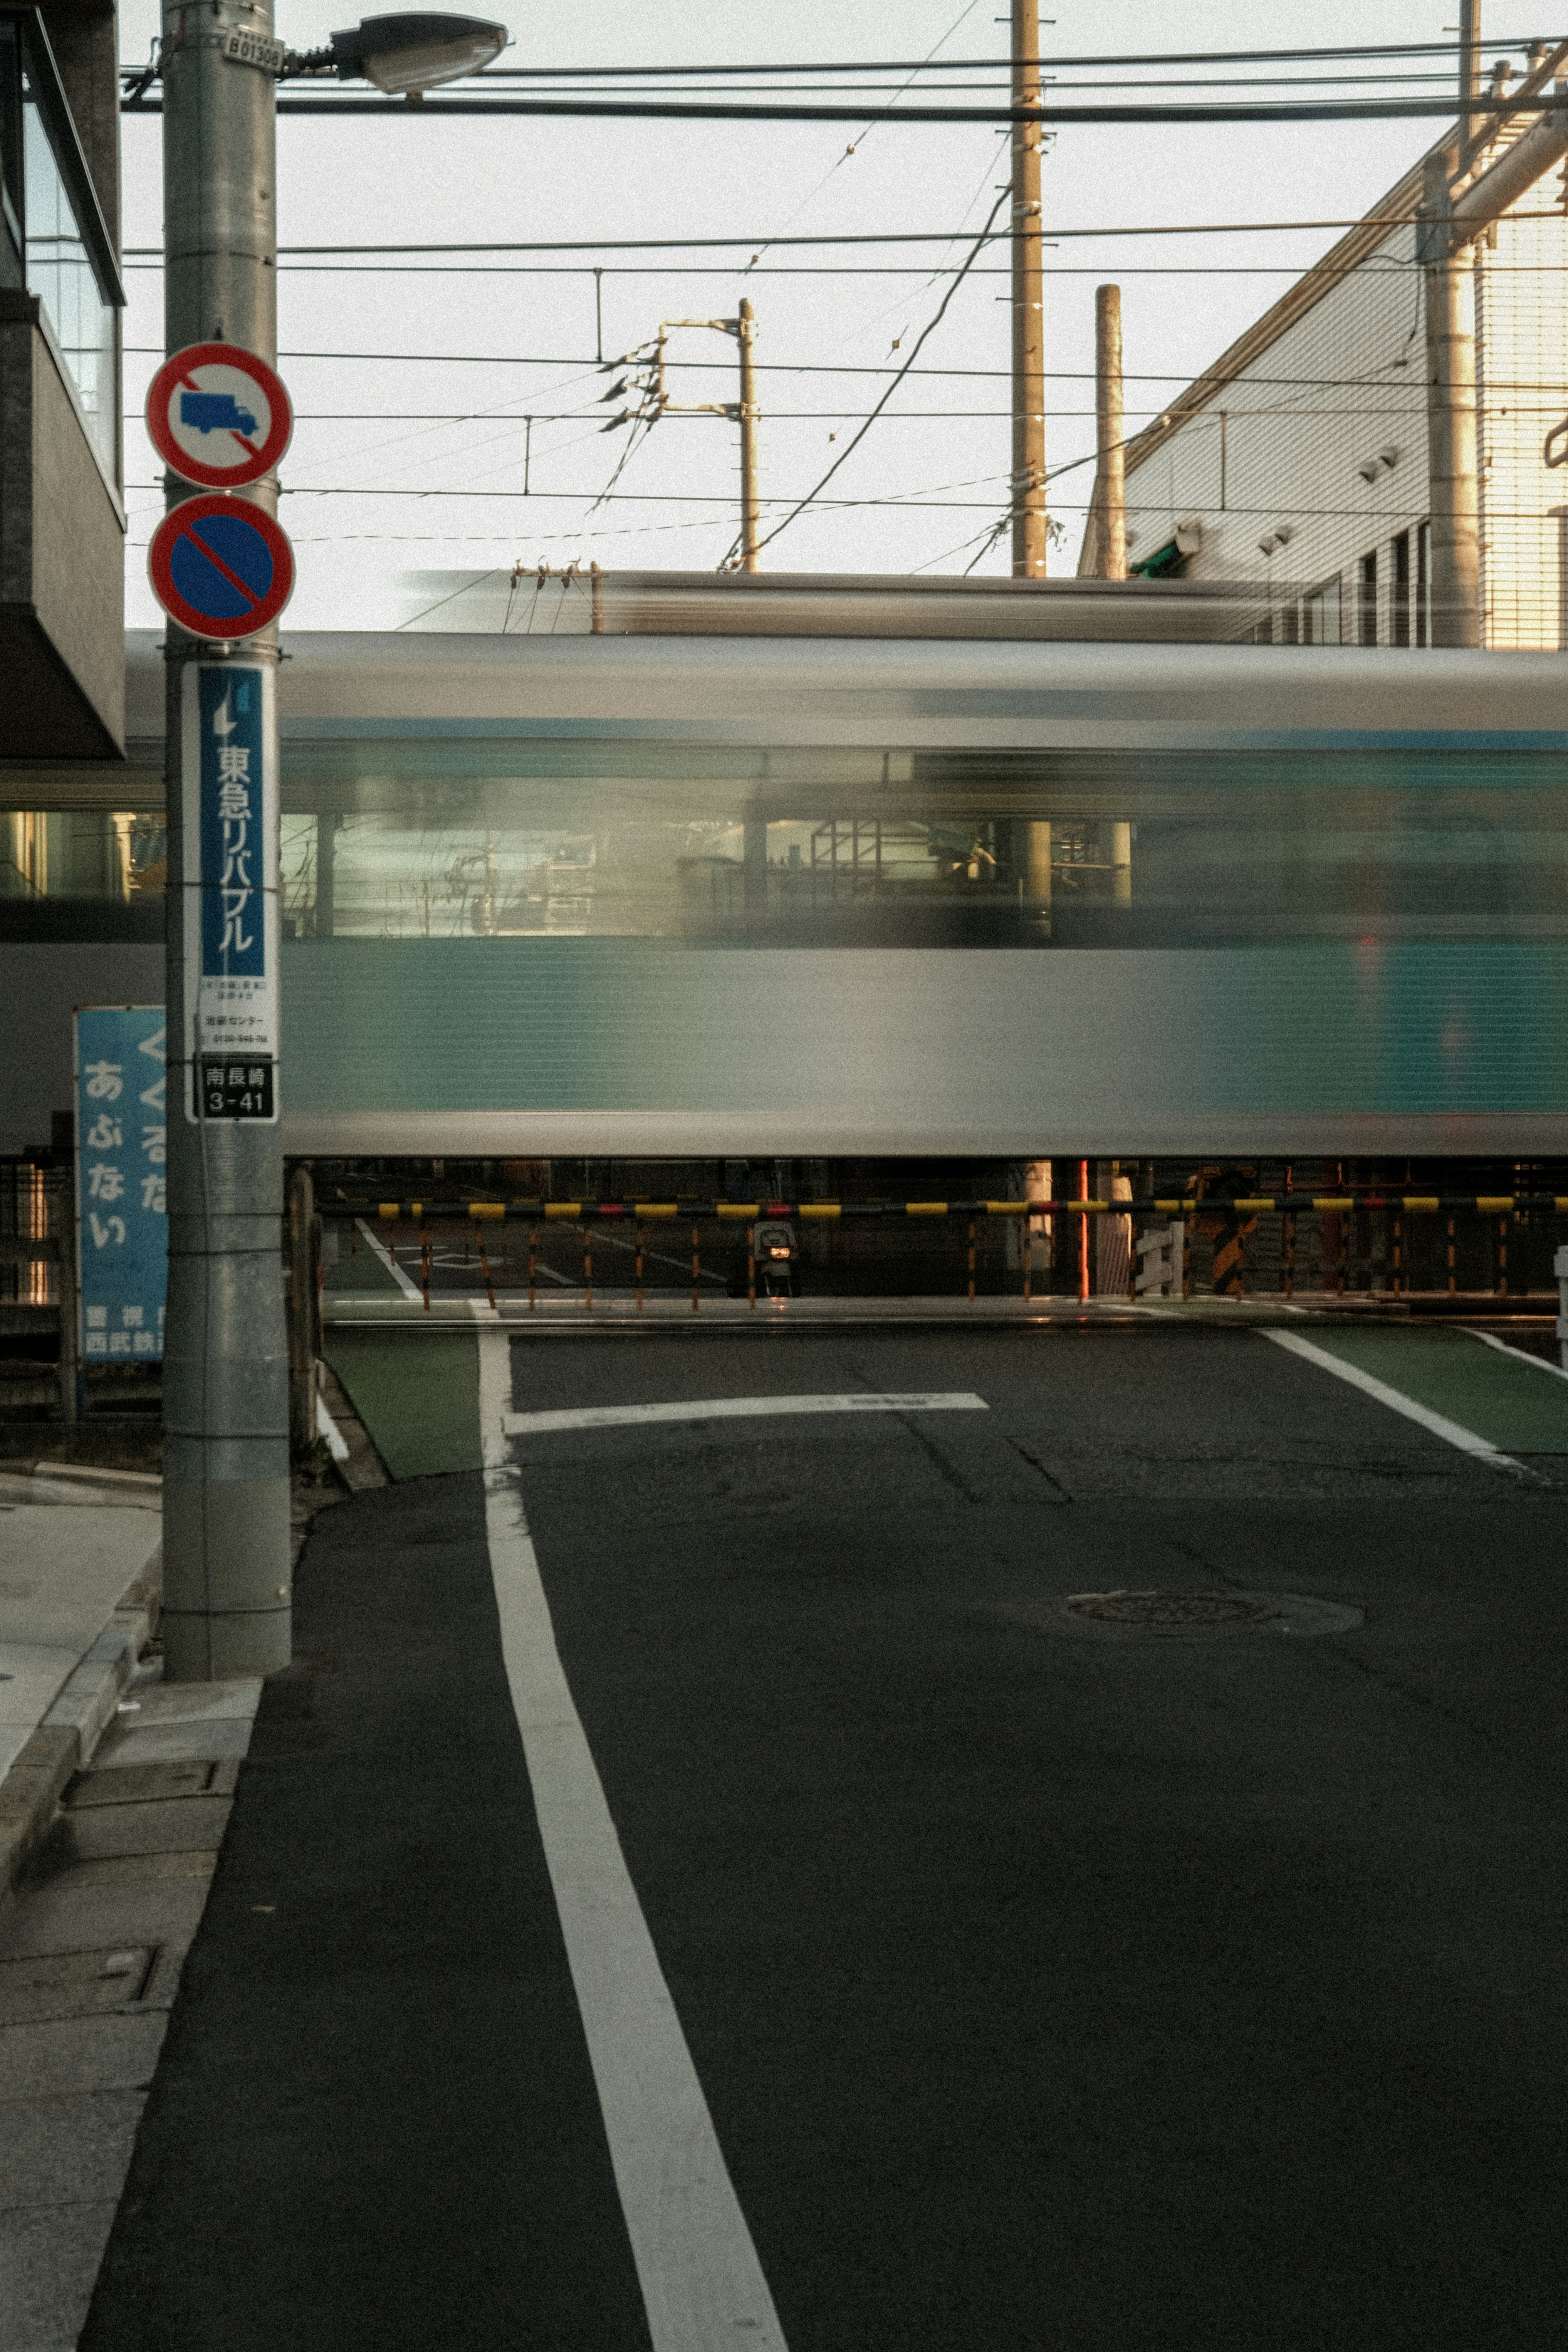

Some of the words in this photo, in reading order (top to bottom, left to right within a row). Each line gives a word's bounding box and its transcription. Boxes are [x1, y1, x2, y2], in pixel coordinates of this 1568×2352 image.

[217, 745, 254, 951] 東急リバブル
[205, 1067, 265, 1087] 南長崎
[209, 1091, 263, 1112] 3-41
[84, 1059, 126, 1248] あぶない
[86, 1305, 166, 1327] 警視
[86, 1331, 164, 1353] 西武鉄
